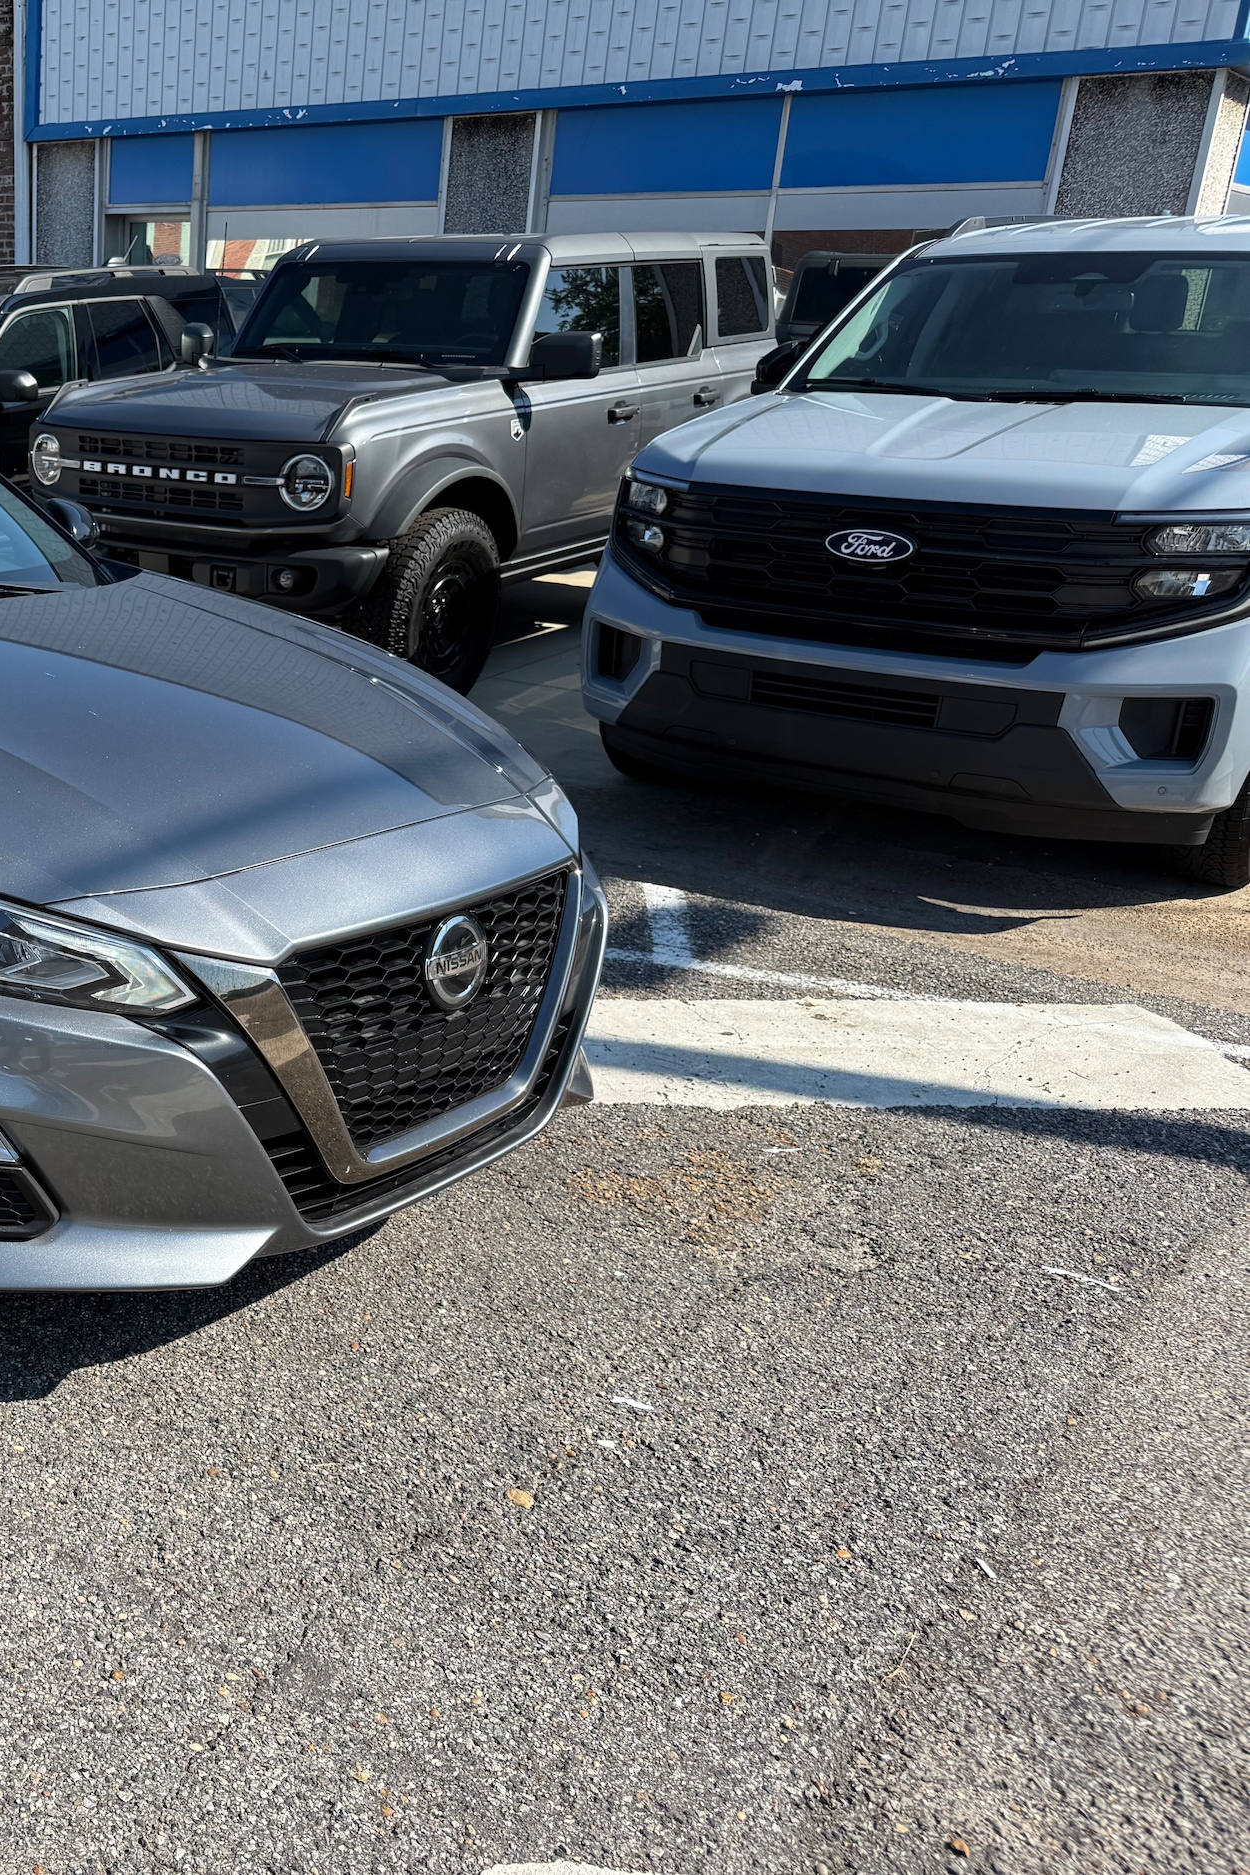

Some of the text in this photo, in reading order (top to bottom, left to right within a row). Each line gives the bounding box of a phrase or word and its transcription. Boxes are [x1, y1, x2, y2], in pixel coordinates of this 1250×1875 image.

[83, 460, 237, 485] BRONCO
[840, 533, 897, 557] Ford
[437, 949, 482, 974] NISSAN
